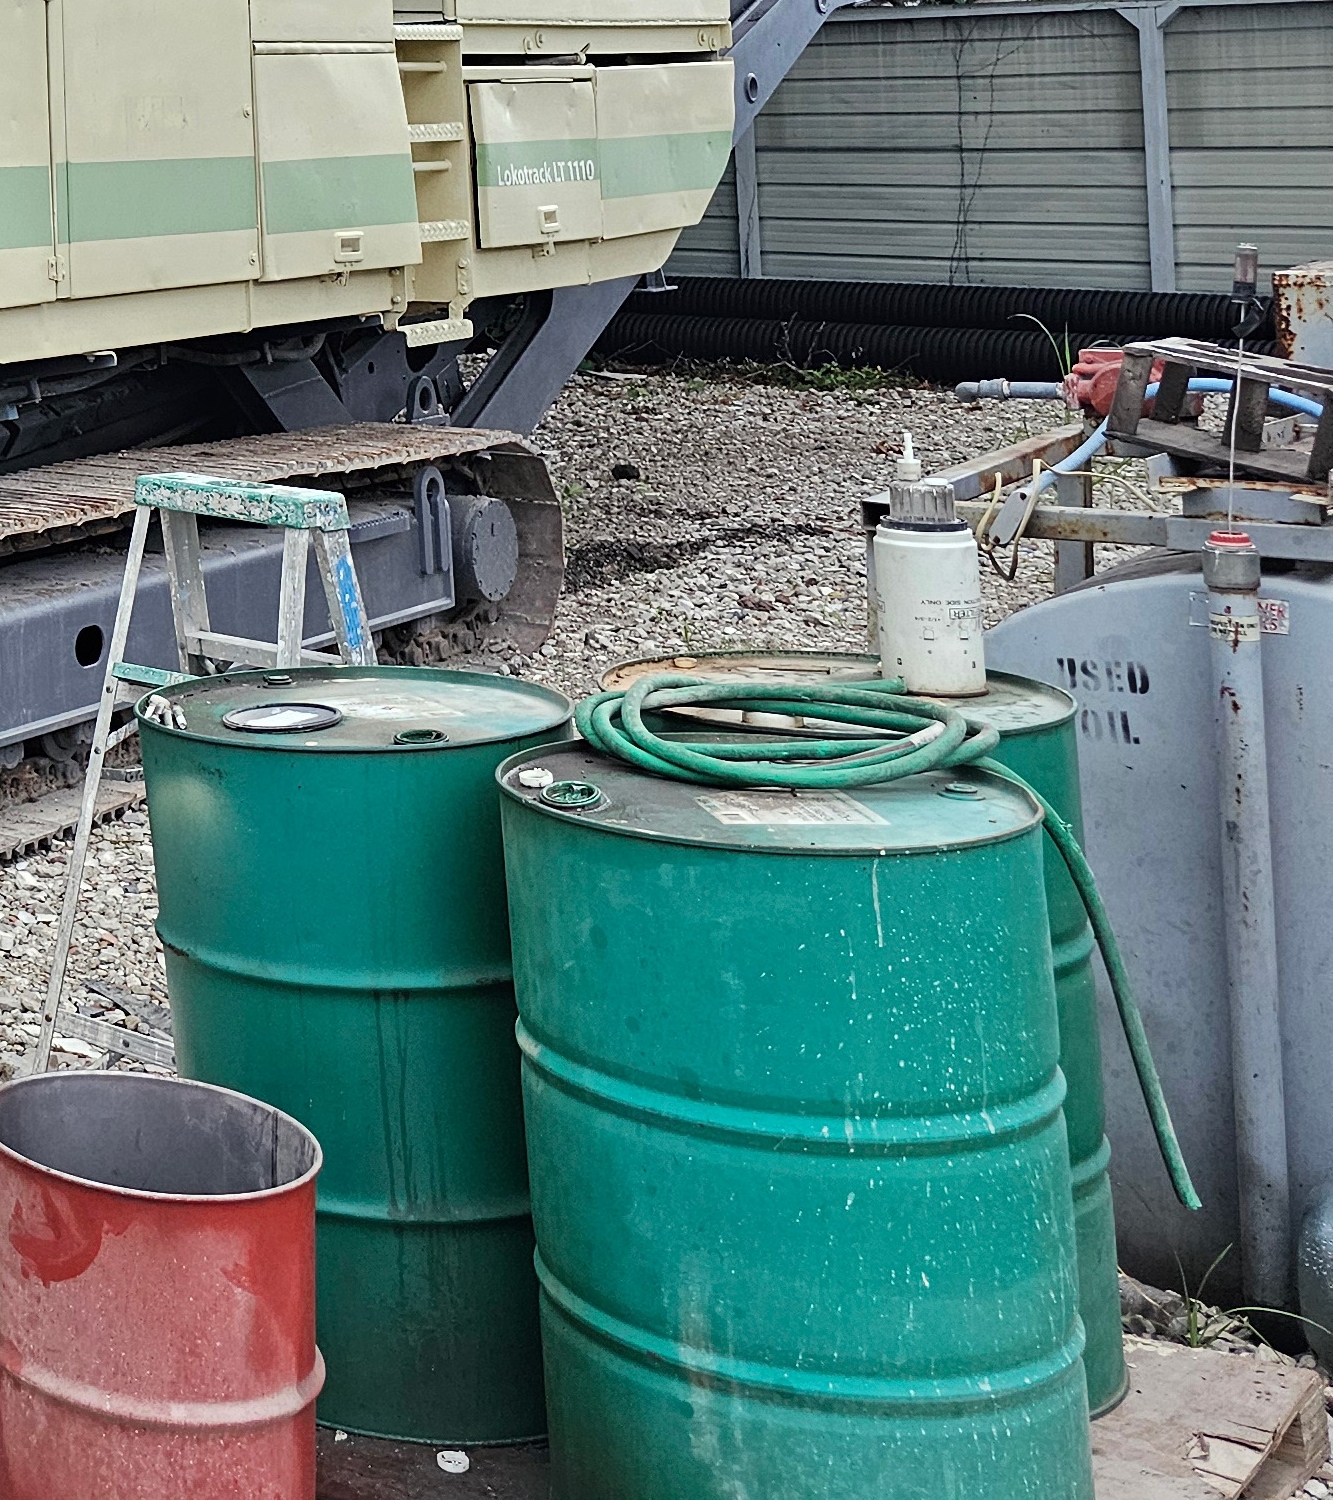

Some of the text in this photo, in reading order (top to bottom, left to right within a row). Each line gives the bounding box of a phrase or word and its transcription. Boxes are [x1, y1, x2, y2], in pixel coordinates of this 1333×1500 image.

[497, 159, 595, 185] Lokotrack LT 1110
[1056, 657, 1150, 694] USED
[1081, 709, 1140, 745] OIL
